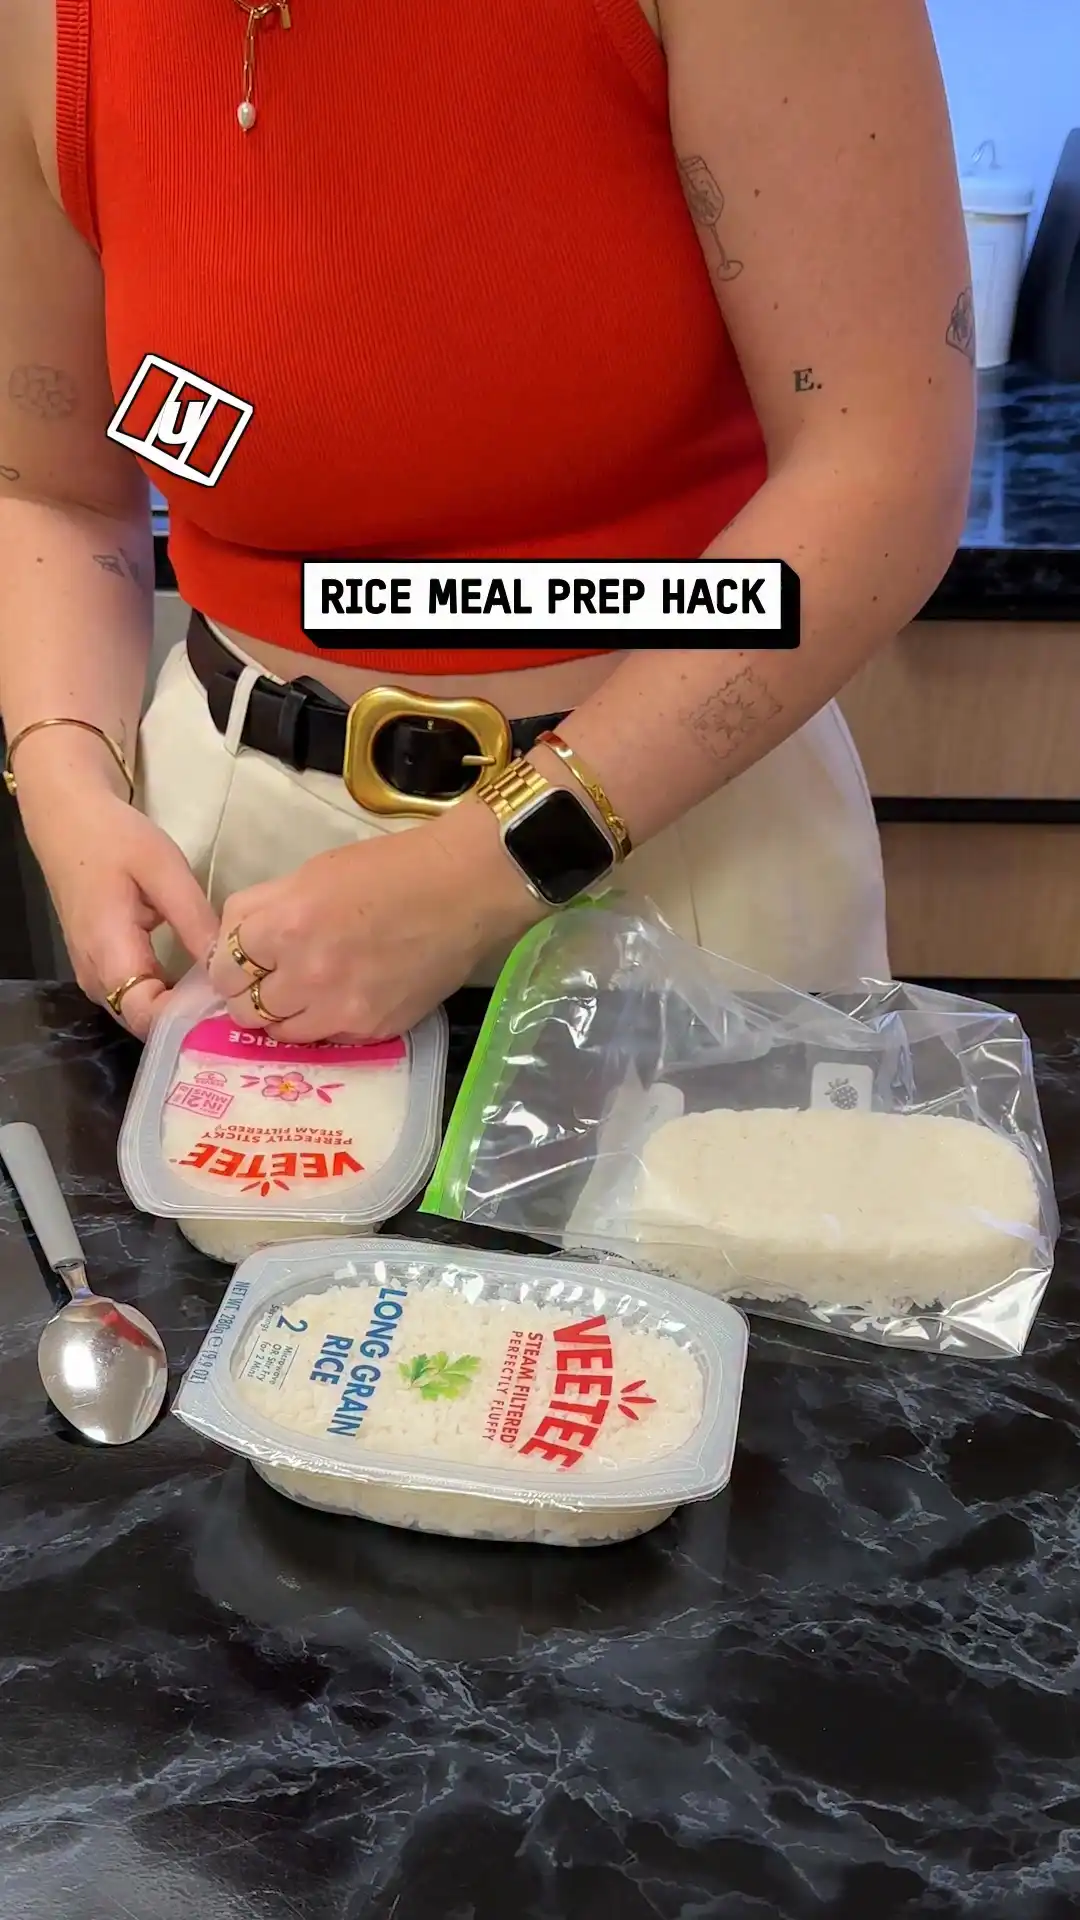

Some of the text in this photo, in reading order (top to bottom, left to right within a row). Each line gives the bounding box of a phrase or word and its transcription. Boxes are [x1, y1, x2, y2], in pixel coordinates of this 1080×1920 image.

[186, 1095, 203, 1107] 2
[192, 1089, 228, 1103] MINS
[202, 1099, 223, 1111] IN
[201, 1131, 353, 1146] PERFECTLY STICKY
[295, 1126, 343, 1137] STEAM
[178, 1143, 365, 1178] VEETEE
[232, 1281, 250, 1297] NET
[210, 1313, 235, 1335] 280g
[261, 1304, 280, 1332] Servings
[276, 1315, 308, 1333] 2
[260, 1340, 269, 1353] for
[248, 1361, 263, 1378] Mins
[258, 1343, 280, 1383] OR Stir Fry
[269, 1345, 294, 1385] Microwave
[309, 1334, 355, 1385] RICE
[326, 1287, 408, 1437] LONG GRAIN
[482, 1330, 523, 1441] PERFECTLY FLUFFY
[500, 1332, 544, 1444] STEAM FILTERED
[517, 1314, 614, 1468] VEETEE
